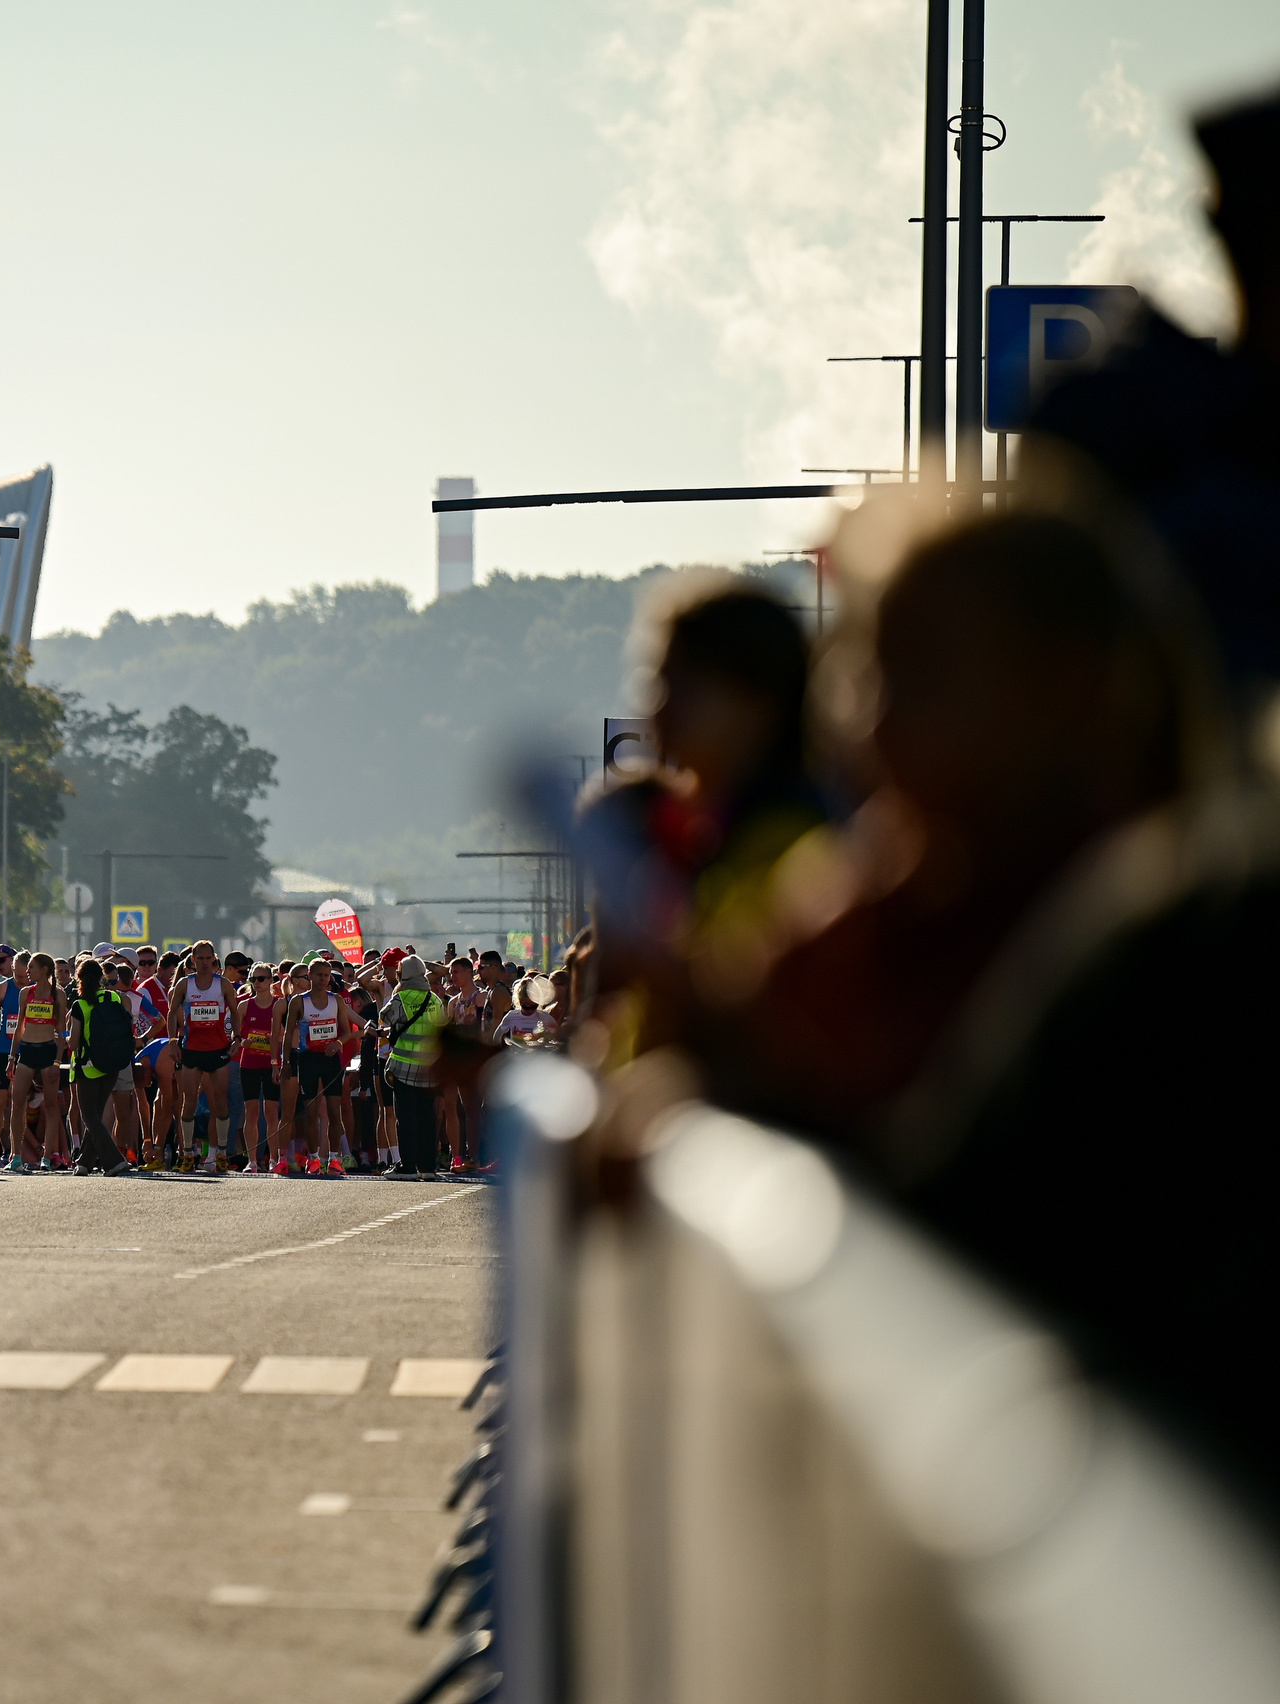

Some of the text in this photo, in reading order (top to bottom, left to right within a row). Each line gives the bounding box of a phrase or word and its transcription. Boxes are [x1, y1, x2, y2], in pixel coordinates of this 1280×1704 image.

[28, 1006, 50, 1014] ТРОПИНА
[193, 1007, 216, 1015] ЛЕЙМАН
[312, 1026, 334, 1034] ЯКУШЕВ
